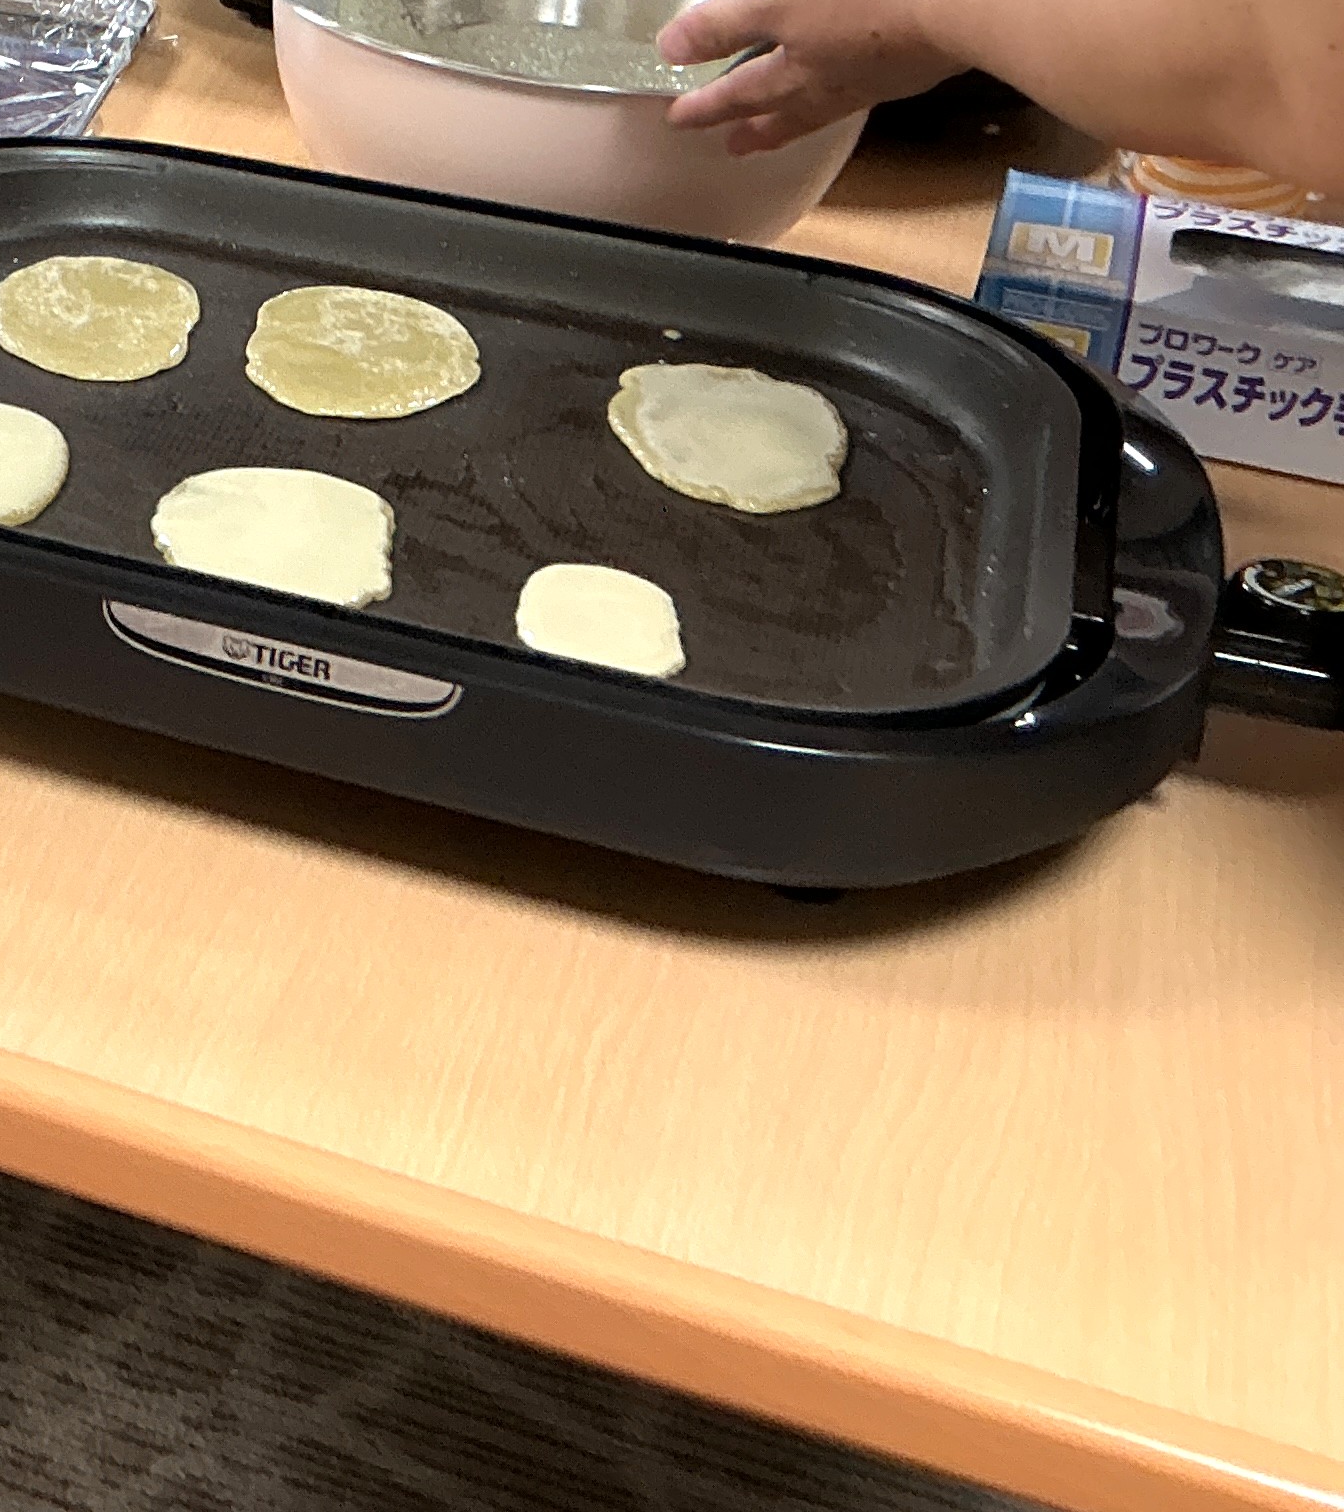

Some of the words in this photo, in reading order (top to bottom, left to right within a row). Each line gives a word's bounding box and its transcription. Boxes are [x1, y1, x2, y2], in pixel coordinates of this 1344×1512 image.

[1025, 224, 1096, 263] M
[1152, 201, 1344, 253] プラスチッ
[1138, 321, 1262, 365] プロワーク
[1273, 352, 1317, 373] ケア
[253, 643, 331, 681] TIGER
